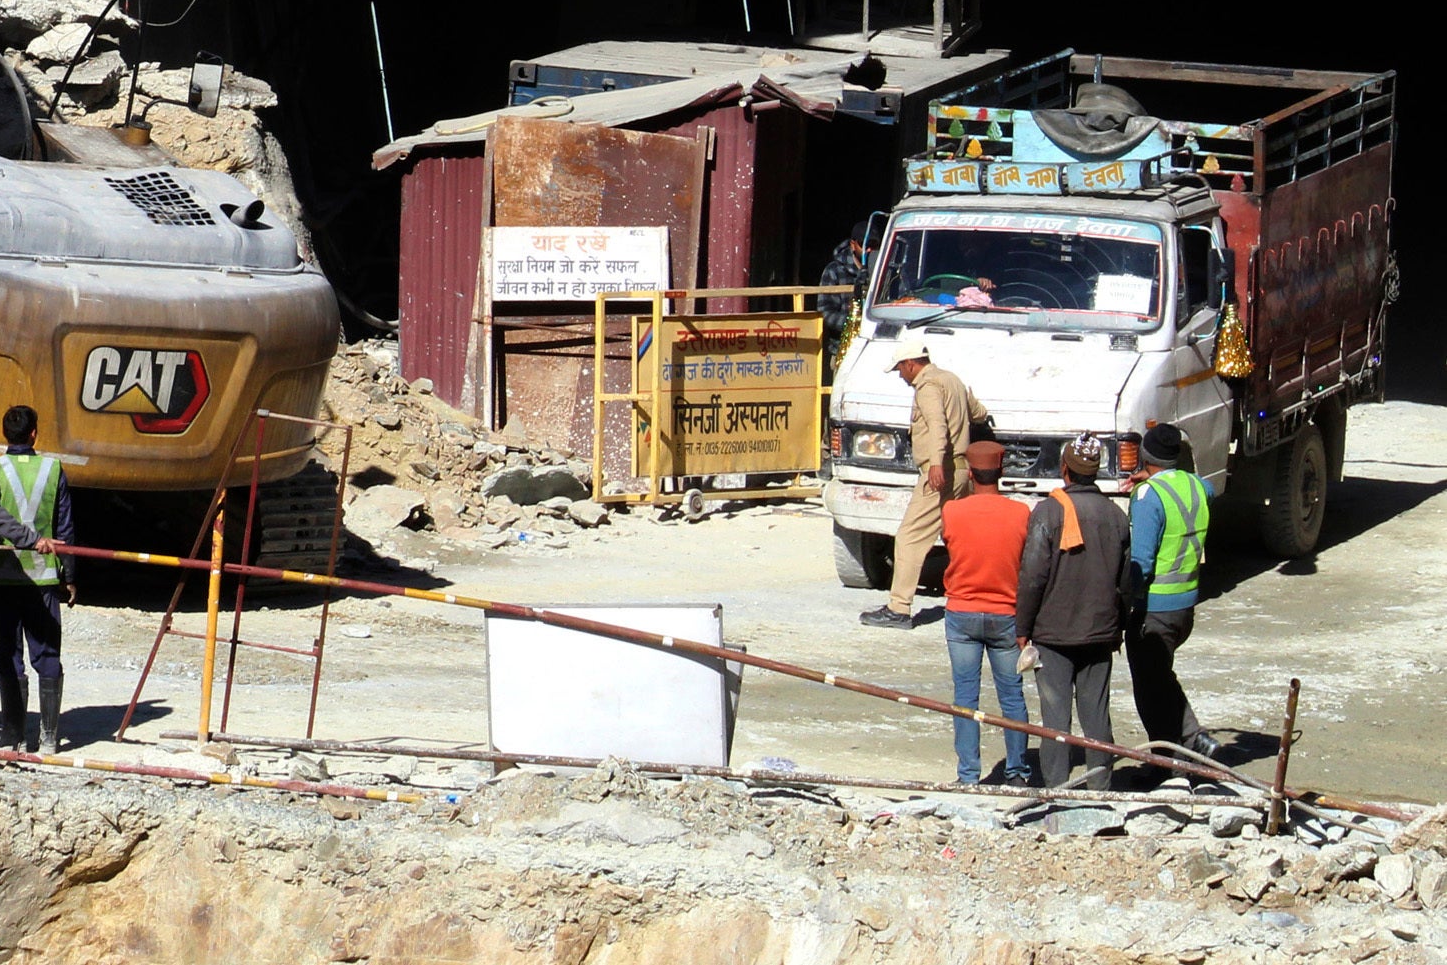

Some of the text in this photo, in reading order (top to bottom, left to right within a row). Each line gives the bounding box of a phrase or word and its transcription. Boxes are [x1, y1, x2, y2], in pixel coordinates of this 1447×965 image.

[1025, 167, 1058, 188] नाग
[1081, 161, 1125, 187] देवता
[913, 213, 958, 226] जय
[1075, 217, 1138, 237] देवता
[531, 235, 569, 252] याद
[498, 260, 524, 276] सुरक्षा
[526, 255, 555, 273] नियम
[559, 255, 574, 273] जो
[605, 260, 639, 274] सफल
[496, 277, 528, 294] जीवन
[531, 277, 555, 294] कभी
[557, 282, 567, 294] न
[570, 277, 586, 298] हो
[588, 282, 622, 294] उसका
[676, 319, 801, 356] उत्तराखण्ड पुलिस
[82, 346, 187, 414] CAT
[702, 357, 716, 380] की
[736, 361, 764, 378] मास्क
[765, 354, 774, 381] है
[673, 394, 792, 434] सिनर्जी अस्पताल
